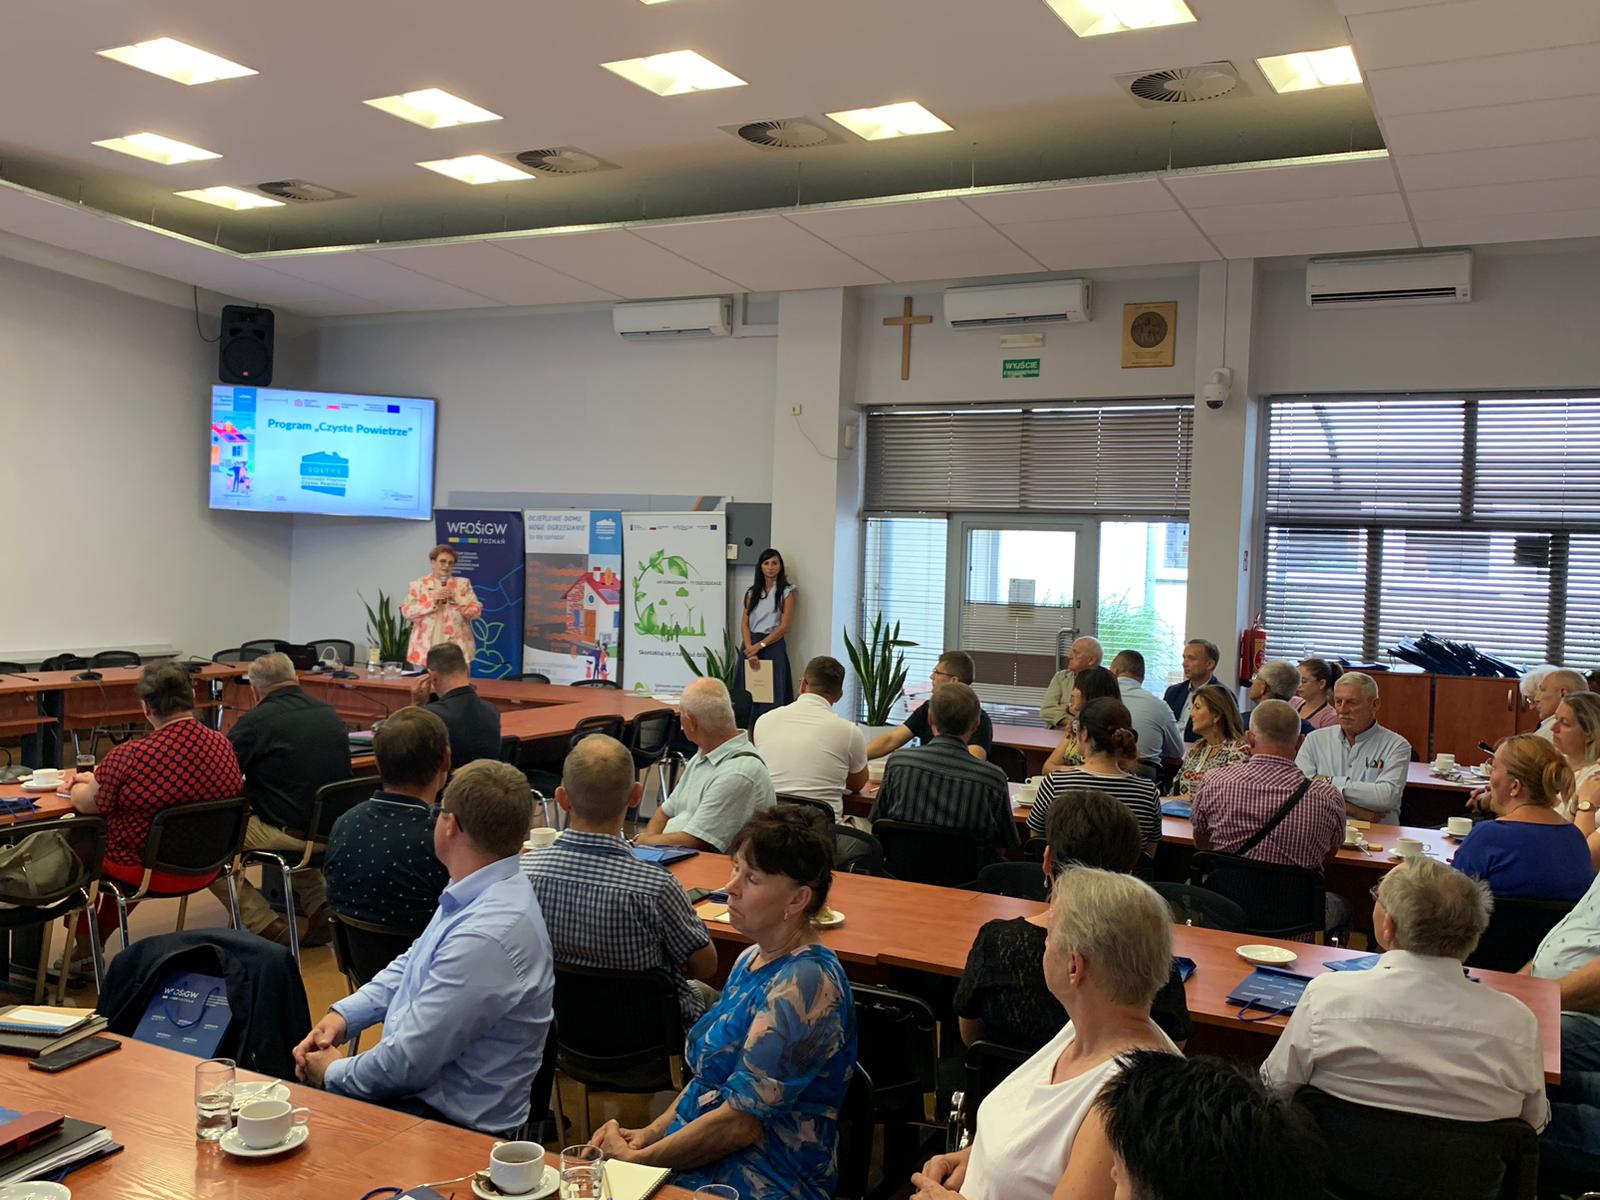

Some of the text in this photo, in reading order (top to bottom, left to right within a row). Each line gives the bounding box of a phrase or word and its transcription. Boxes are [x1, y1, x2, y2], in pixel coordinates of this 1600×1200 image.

[1005, 361, 1038, 369] WYJŚCIE
[267, 418, 312, 431] Program
[314, 421, 353, 434] „Czyste
[446, 520, 508, 535] WFOŚiGW
